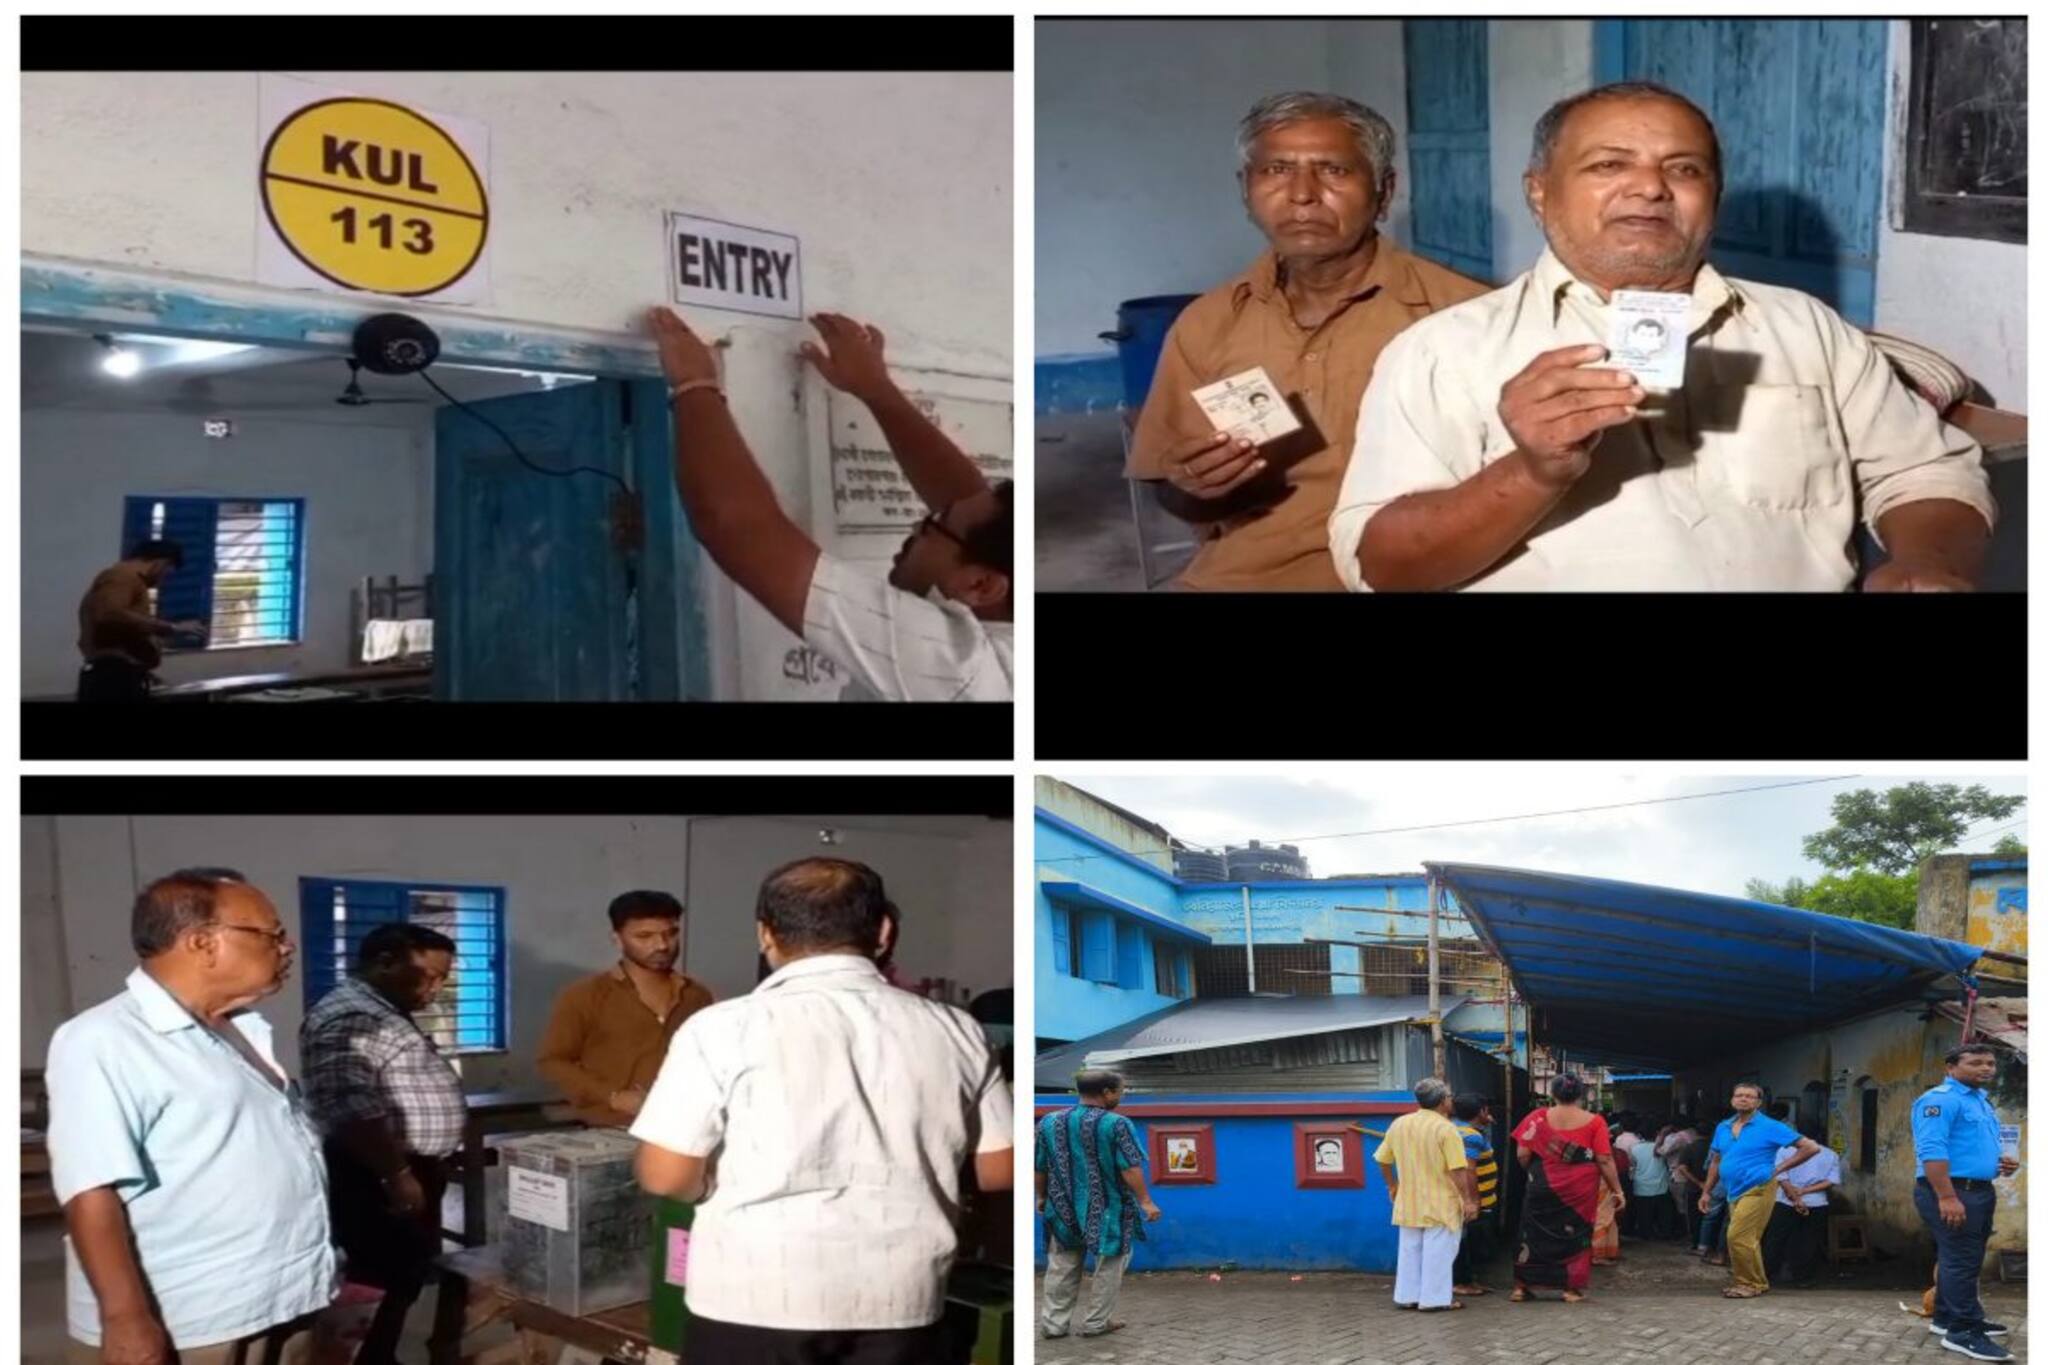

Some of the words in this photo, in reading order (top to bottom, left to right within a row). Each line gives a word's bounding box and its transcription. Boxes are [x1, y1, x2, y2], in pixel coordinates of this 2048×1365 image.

[322, 134, 438, 194] KUL
[331, 206, 435, 255] 113
[678, 232, 793, 301] ENTRY
[782, 646, 838, 686] প্রবে
